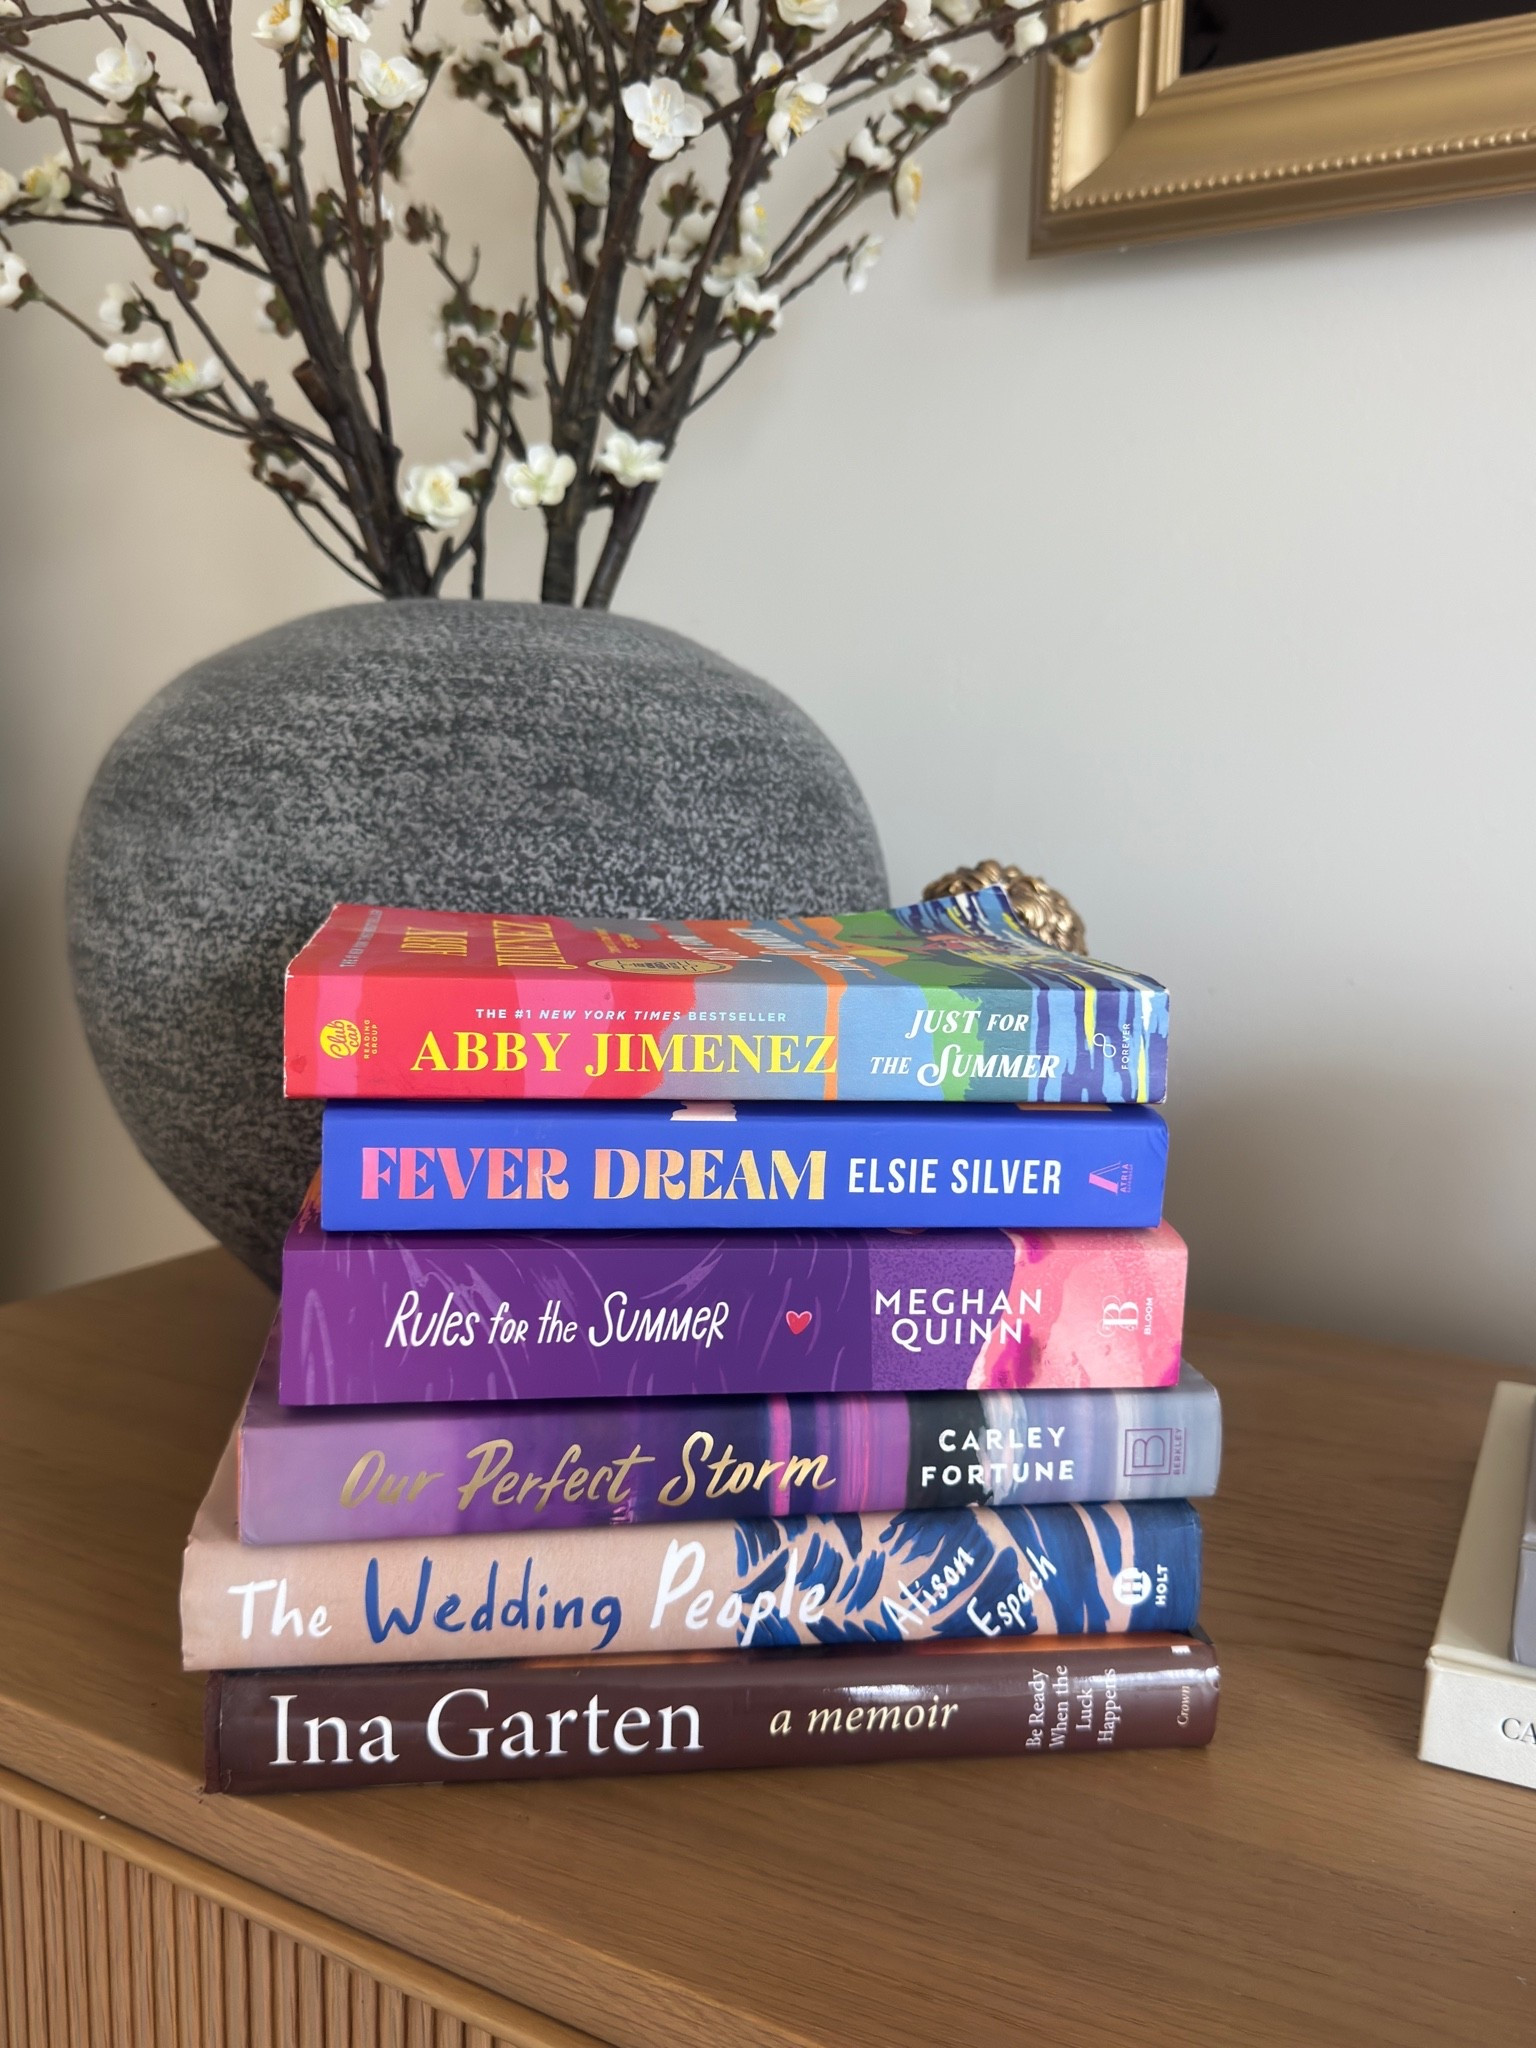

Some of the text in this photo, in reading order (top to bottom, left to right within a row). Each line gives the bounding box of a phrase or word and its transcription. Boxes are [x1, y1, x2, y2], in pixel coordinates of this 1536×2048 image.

[400, 926, 468, 957] ABBY
[492, 920, 578, 970] JIMENEZ
[349, 1024, 360, 1048] car
[476, 1008, 787, 1022] THE #1 NEW YORK TIMES BESTSELLER
[904, 1009, 1030, 1039] JUST FOR
[326, 1020, 351, 1058] Club
[363, 1018, 371, 1060] READING
[410, 1030, 838, 1077] ABBY JIMENEZ
[1121, 1023, 1131, 1070] FOREVER
[870, 1043, 1061, 1087] THE SUMMER
[361, 1147, 1061, 1201] FEVER DREAM ELSIE SILVER
[1119, 1163, 1129, 1193] ATRIA
[384, 1290, 480, 1348] Rules
[537, 1299, 578, 1343] the
[875, 1287, 1042, 1315] MEGHAN
[1143, 1297, 1153, 1335] BLOOM
[891, 1317, 1023, 1353] QUINN
[938, 1426, 1067, 1453] CARLEY
[1173, 1427, 1182, 1476] BERKLEY
[340, 1430, 837, 1513] Our Perfect Storm
[921, 1459, 1075, 1488] FORTUNE
[227, 1537, 827, 1651] The Wedding People
[882, 1545, 976, 1635] Alison
[966, 1546, 1060, 1637] Espach
[1155, 1563, 1169, 1606] HOLT
[269, 1687, 959, 1766] Ina Garten a memoir
[1025, 1668, 1049, 1749] Be Ready
[1049, 1665, 1069, 1749] When the
[1075, 1687, 1094, 1732] Luck
[1097, 1667, 1123, 1744] Happens
[1177, 1685, 1192, 1728] Crown
